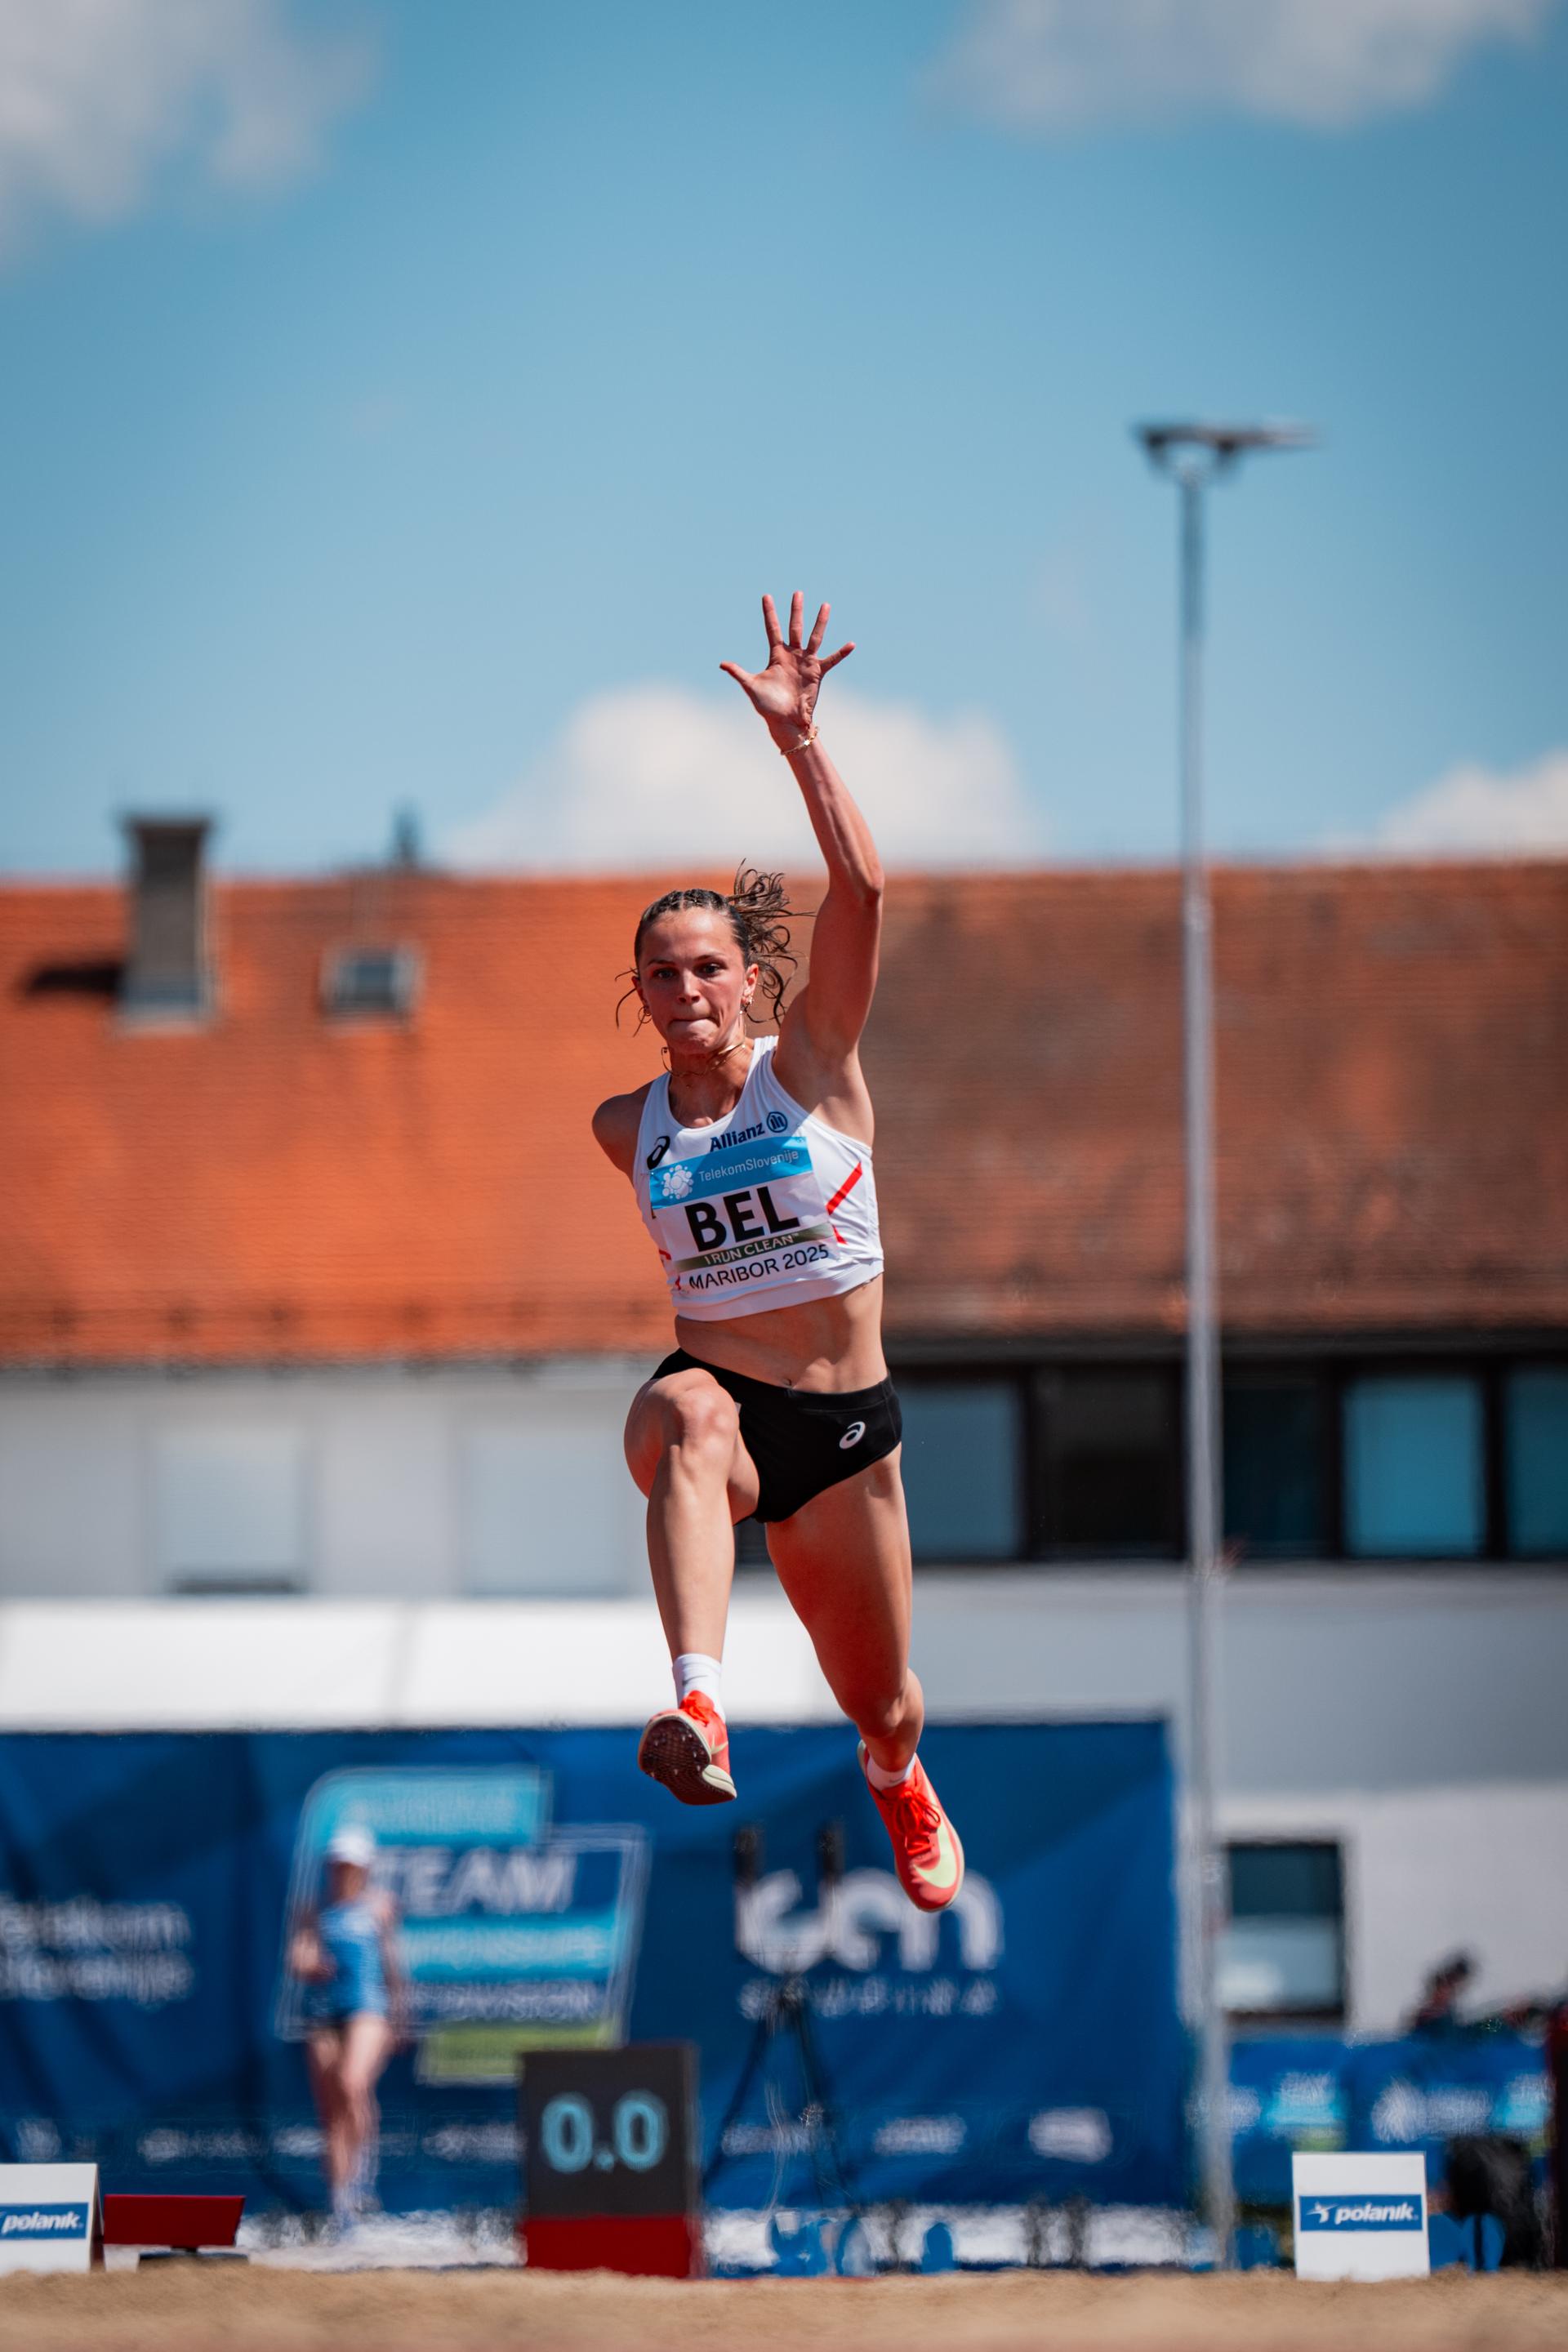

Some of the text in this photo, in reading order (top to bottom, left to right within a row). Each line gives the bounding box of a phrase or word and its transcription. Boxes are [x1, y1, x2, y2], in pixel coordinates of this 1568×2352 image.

[710, 1122, 765, 1152] Allianz
[699, 1150, 799, 1183] TelekomSlovenije
[684, 1186, 800, 1252] BEL
[688, 1244, 830, 1290] MARIBOR 2025
[704, 1255, 711, 1265] I
[711, 1248, 744, 1263] RUN
[541, 2093, 668, 2175] 0.0
[1, 2211, 80, 2234] polanik
[1334, 2202, 1414, 2225] polanik
